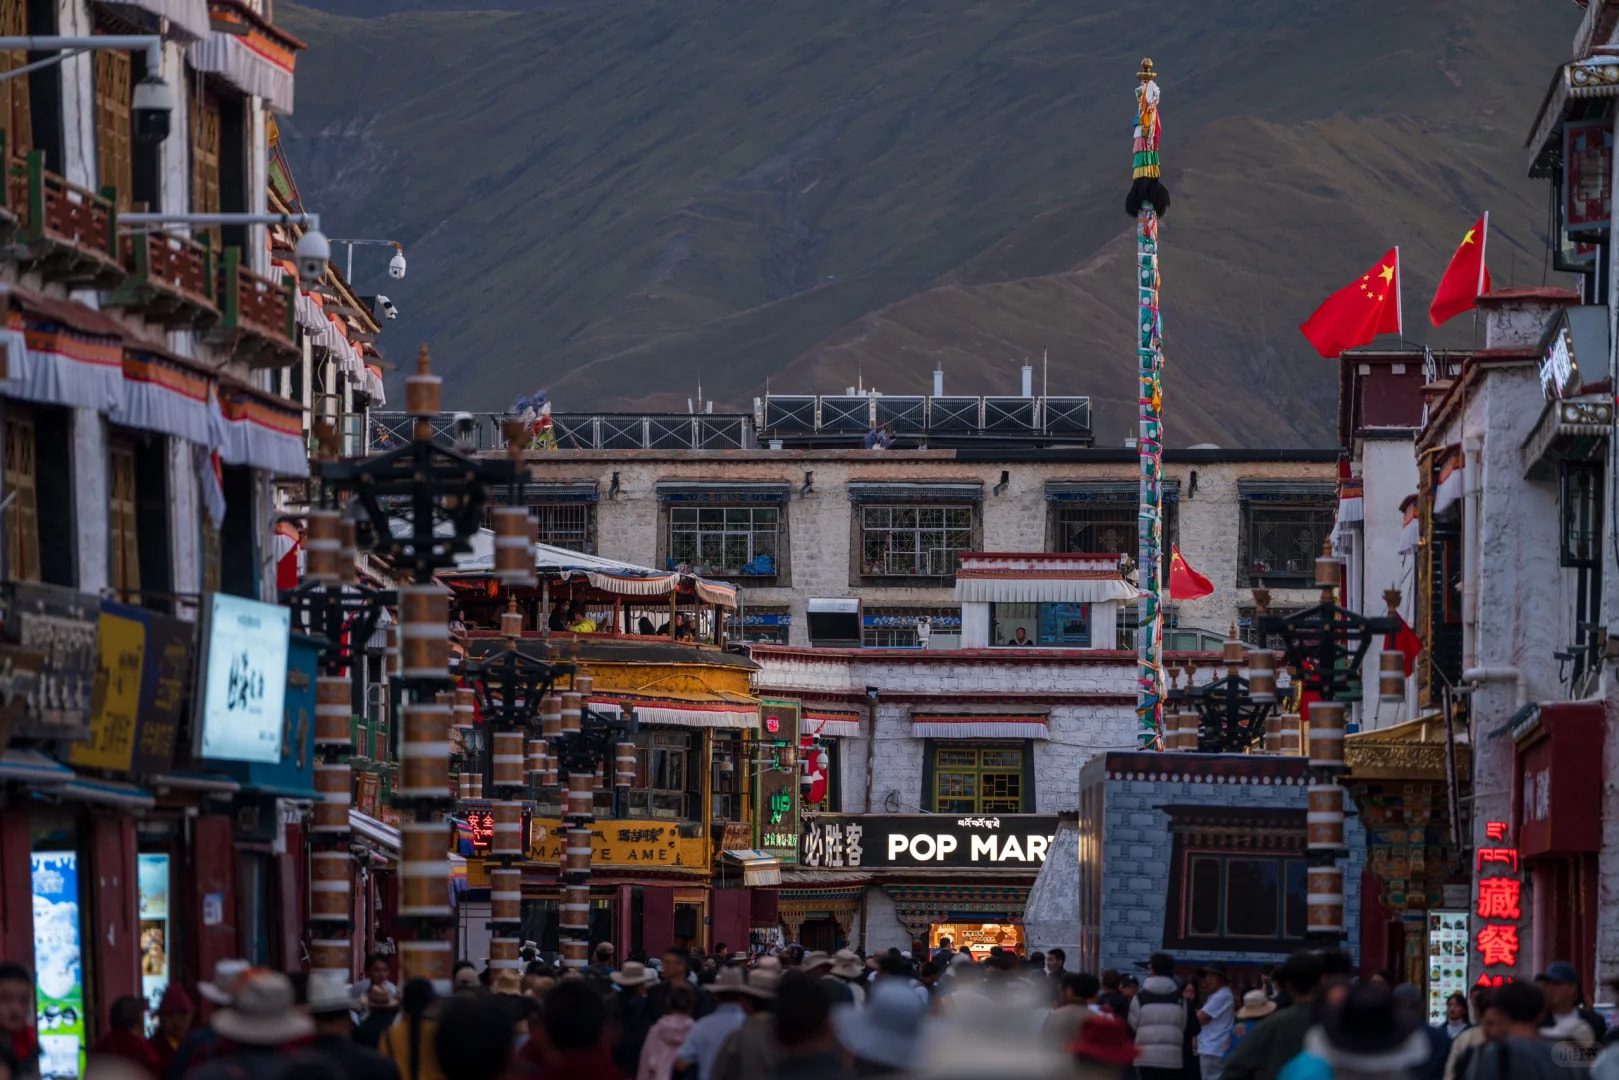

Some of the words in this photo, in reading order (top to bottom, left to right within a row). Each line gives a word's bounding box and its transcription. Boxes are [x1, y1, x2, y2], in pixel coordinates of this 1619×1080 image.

[468, 815, 494, 827] 安全
[628, 849, 667, 861] AME
[804, 822, 863, 868] 必胜客
[888, 833, 958, 862] POP
[971, 834, 1055, 862] MAR
